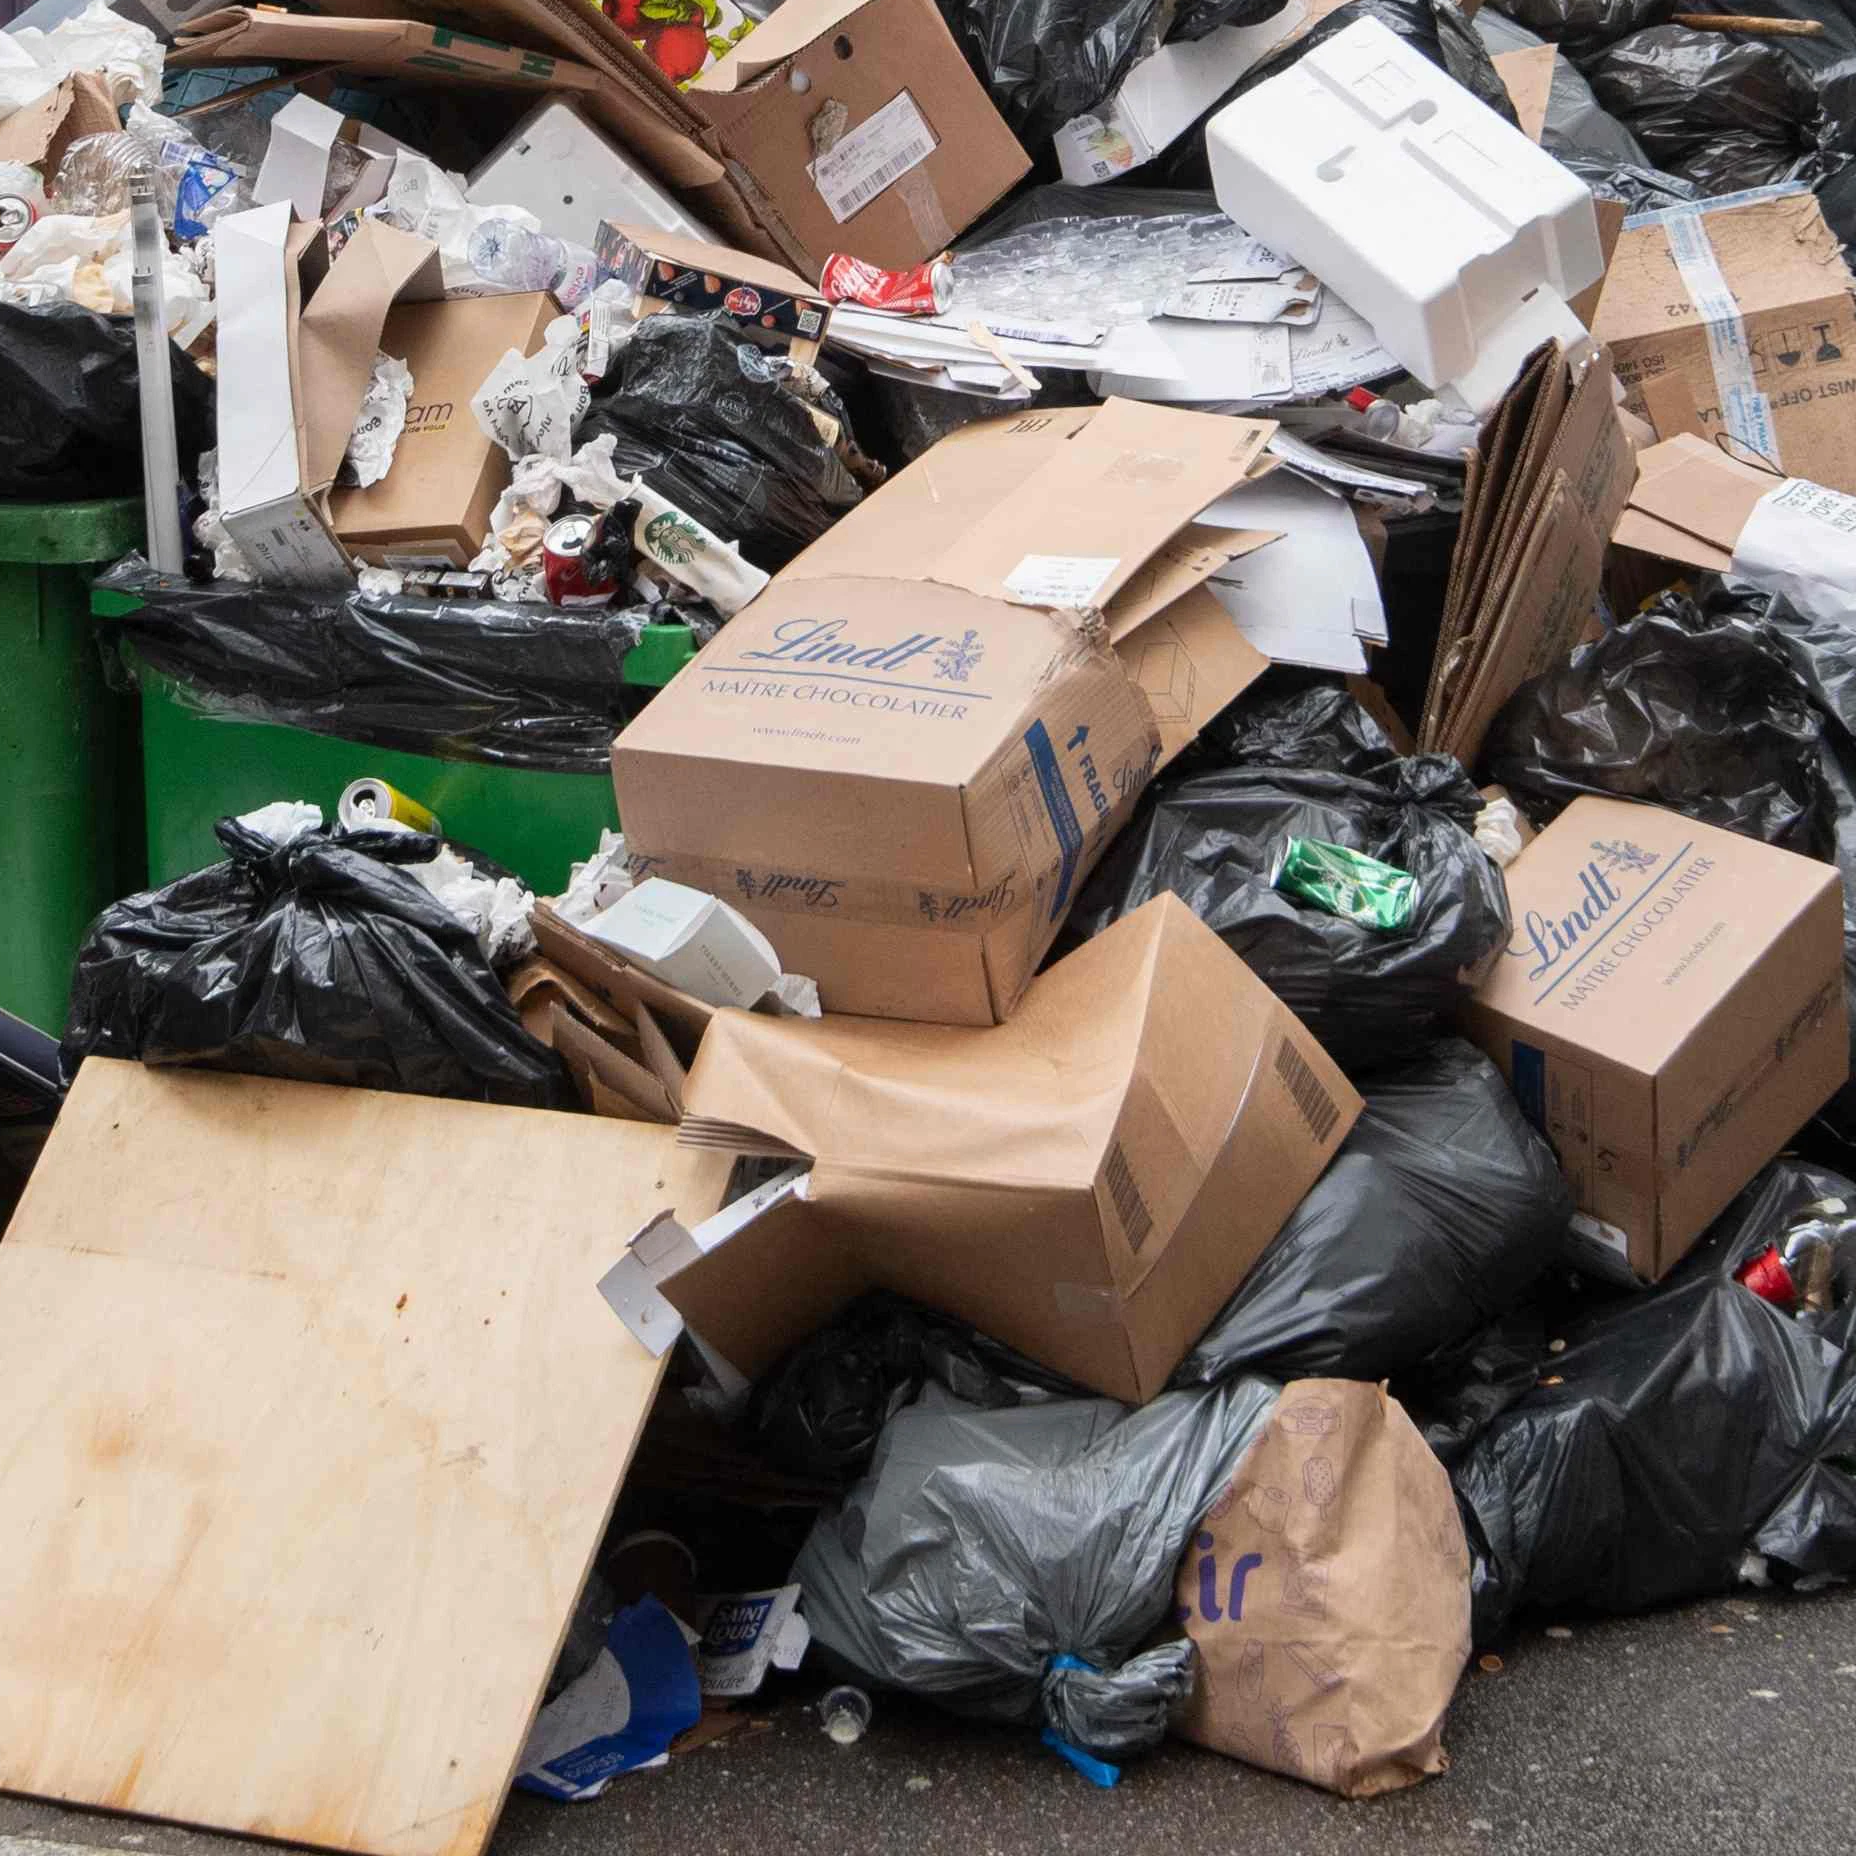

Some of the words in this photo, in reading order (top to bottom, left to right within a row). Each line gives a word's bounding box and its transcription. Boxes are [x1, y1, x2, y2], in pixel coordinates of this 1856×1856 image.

[741, 616, 945, 673] Lindt
[792, 683, 969, 721] CHOCOLATIER
[1502, 861, 1622, 983] Lindt
[1558, 954, 1617, 1012] MAÎTRE
[1607, 854, 1717, 968] CHOCOLATIER
[1662, 919, 1727, 988] www.lindt.com
[1184, 1529, 1263, 1624] ir
[716, 1603, 770, 1624] SAINT
[701, 1674, 746, 1690] oudre
